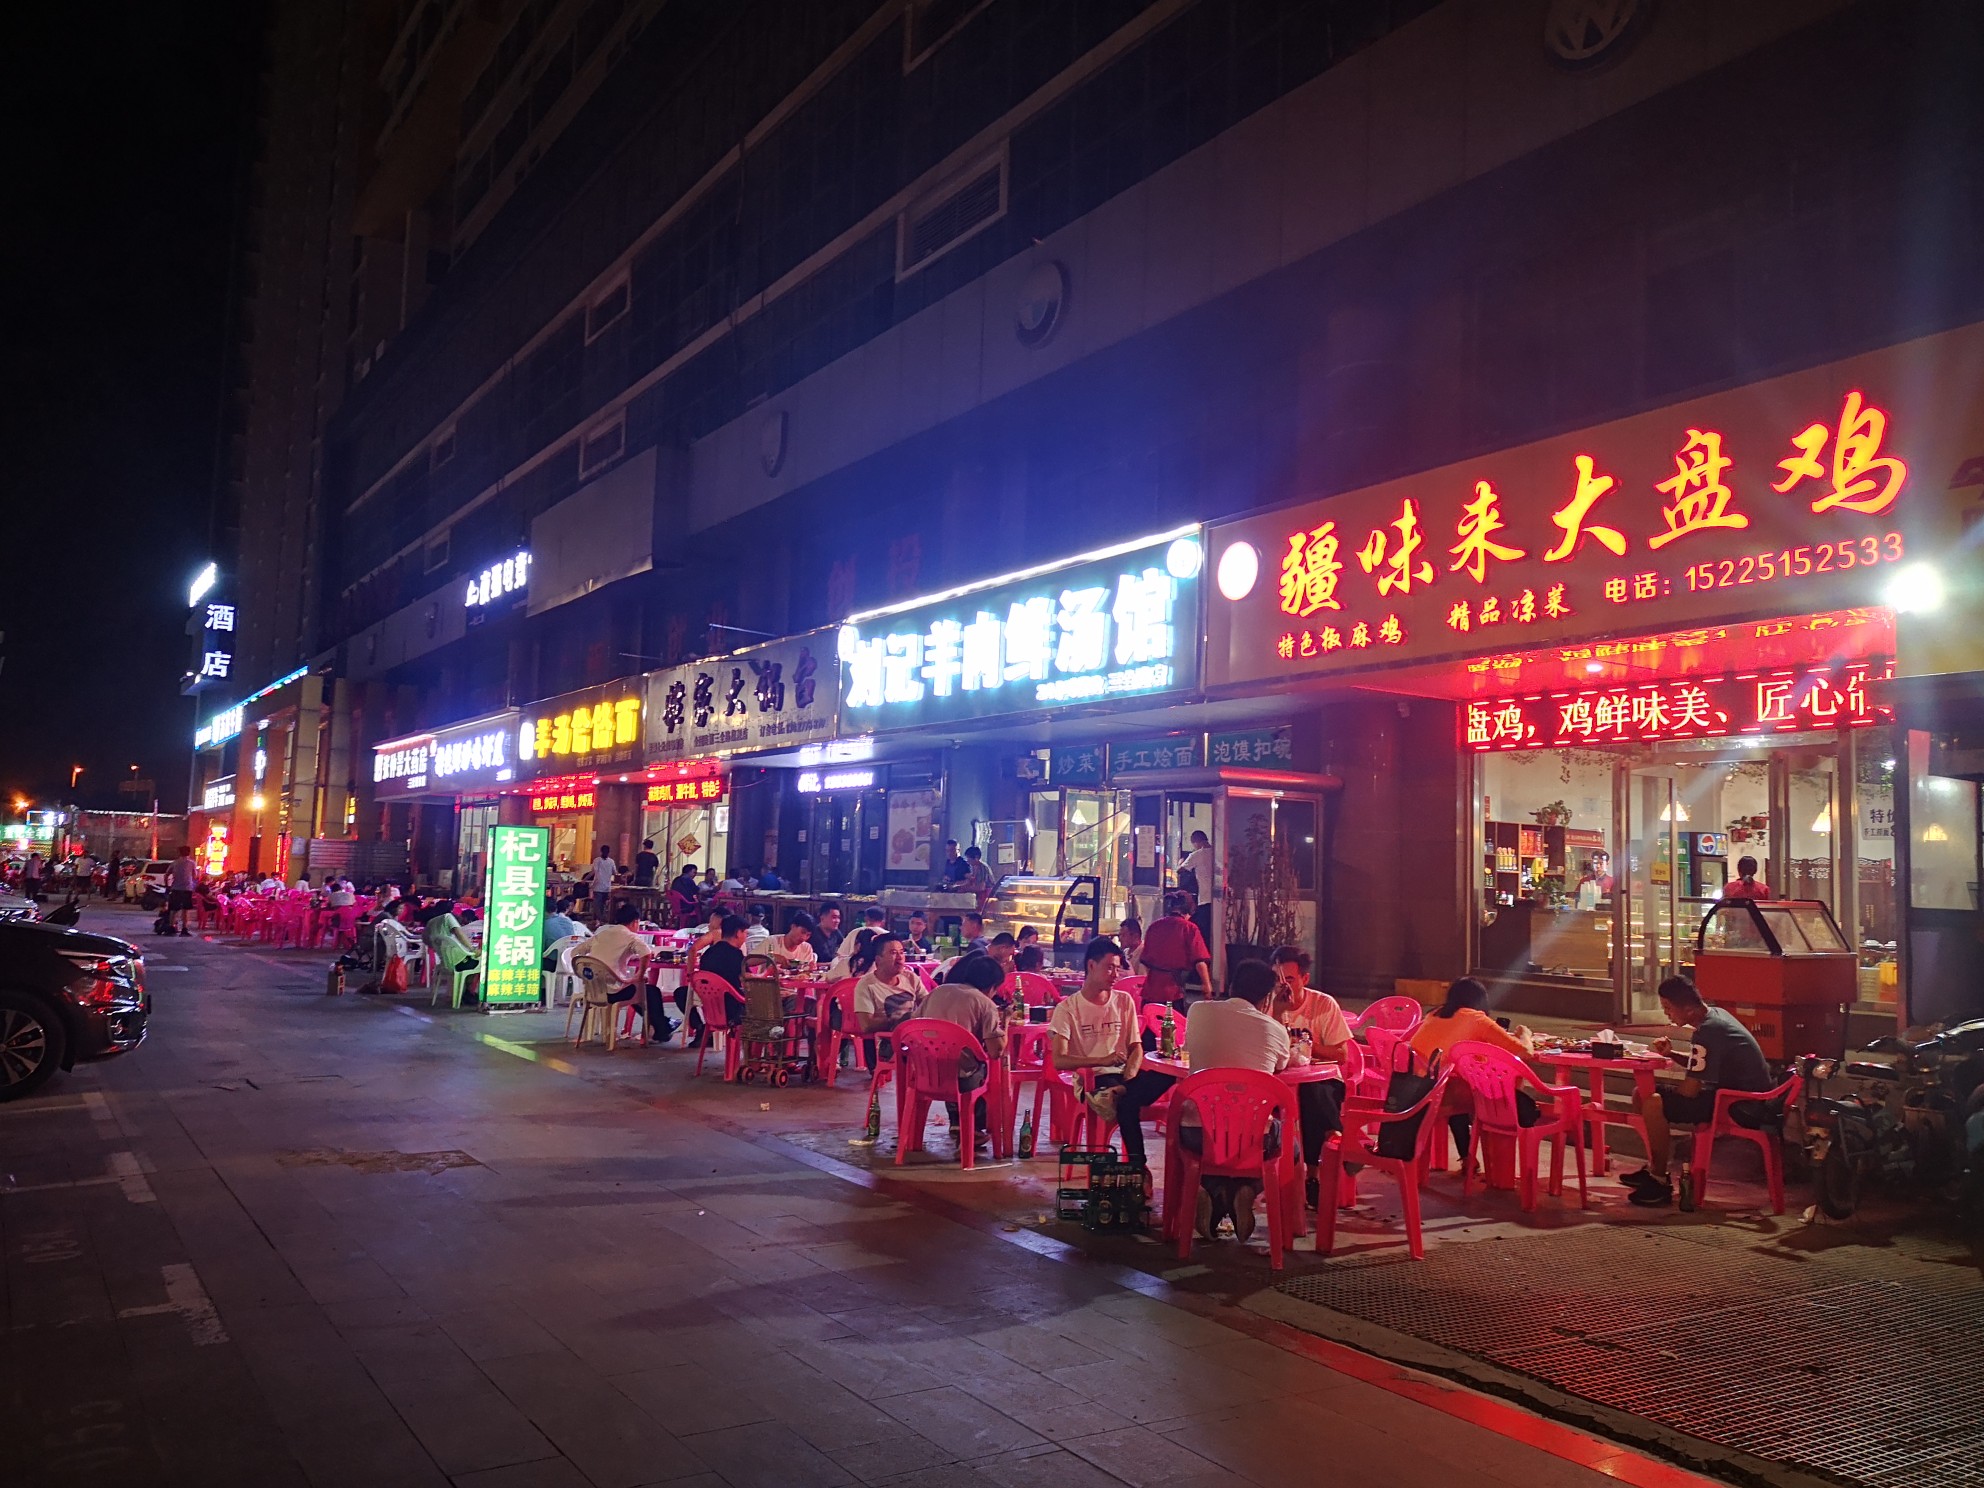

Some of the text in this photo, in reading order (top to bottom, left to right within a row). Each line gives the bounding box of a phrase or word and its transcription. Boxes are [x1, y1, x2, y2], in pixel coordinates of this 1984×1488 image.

[1279, 391, 1907, 618] 疆味来大盘鸡
[1446, 582, 1570, 632] 精品凉菜
[200, 603, 235, 678] 酒店
[846, 567, 1176, 708] 刘记羊肉鲜汤馆
[1277, 613, 1403, 660] 特色椒麻鸡
[1056, 752, 1097, 775] 炒菜
[1114, 746, 1194, 771] 手工烩面
[1214, 737, 1293, 763] 泡馍扣碗
[494, 830, 541, 966] 杞县砂锅
[487, 968, 541, 982] 麻辣羊排
